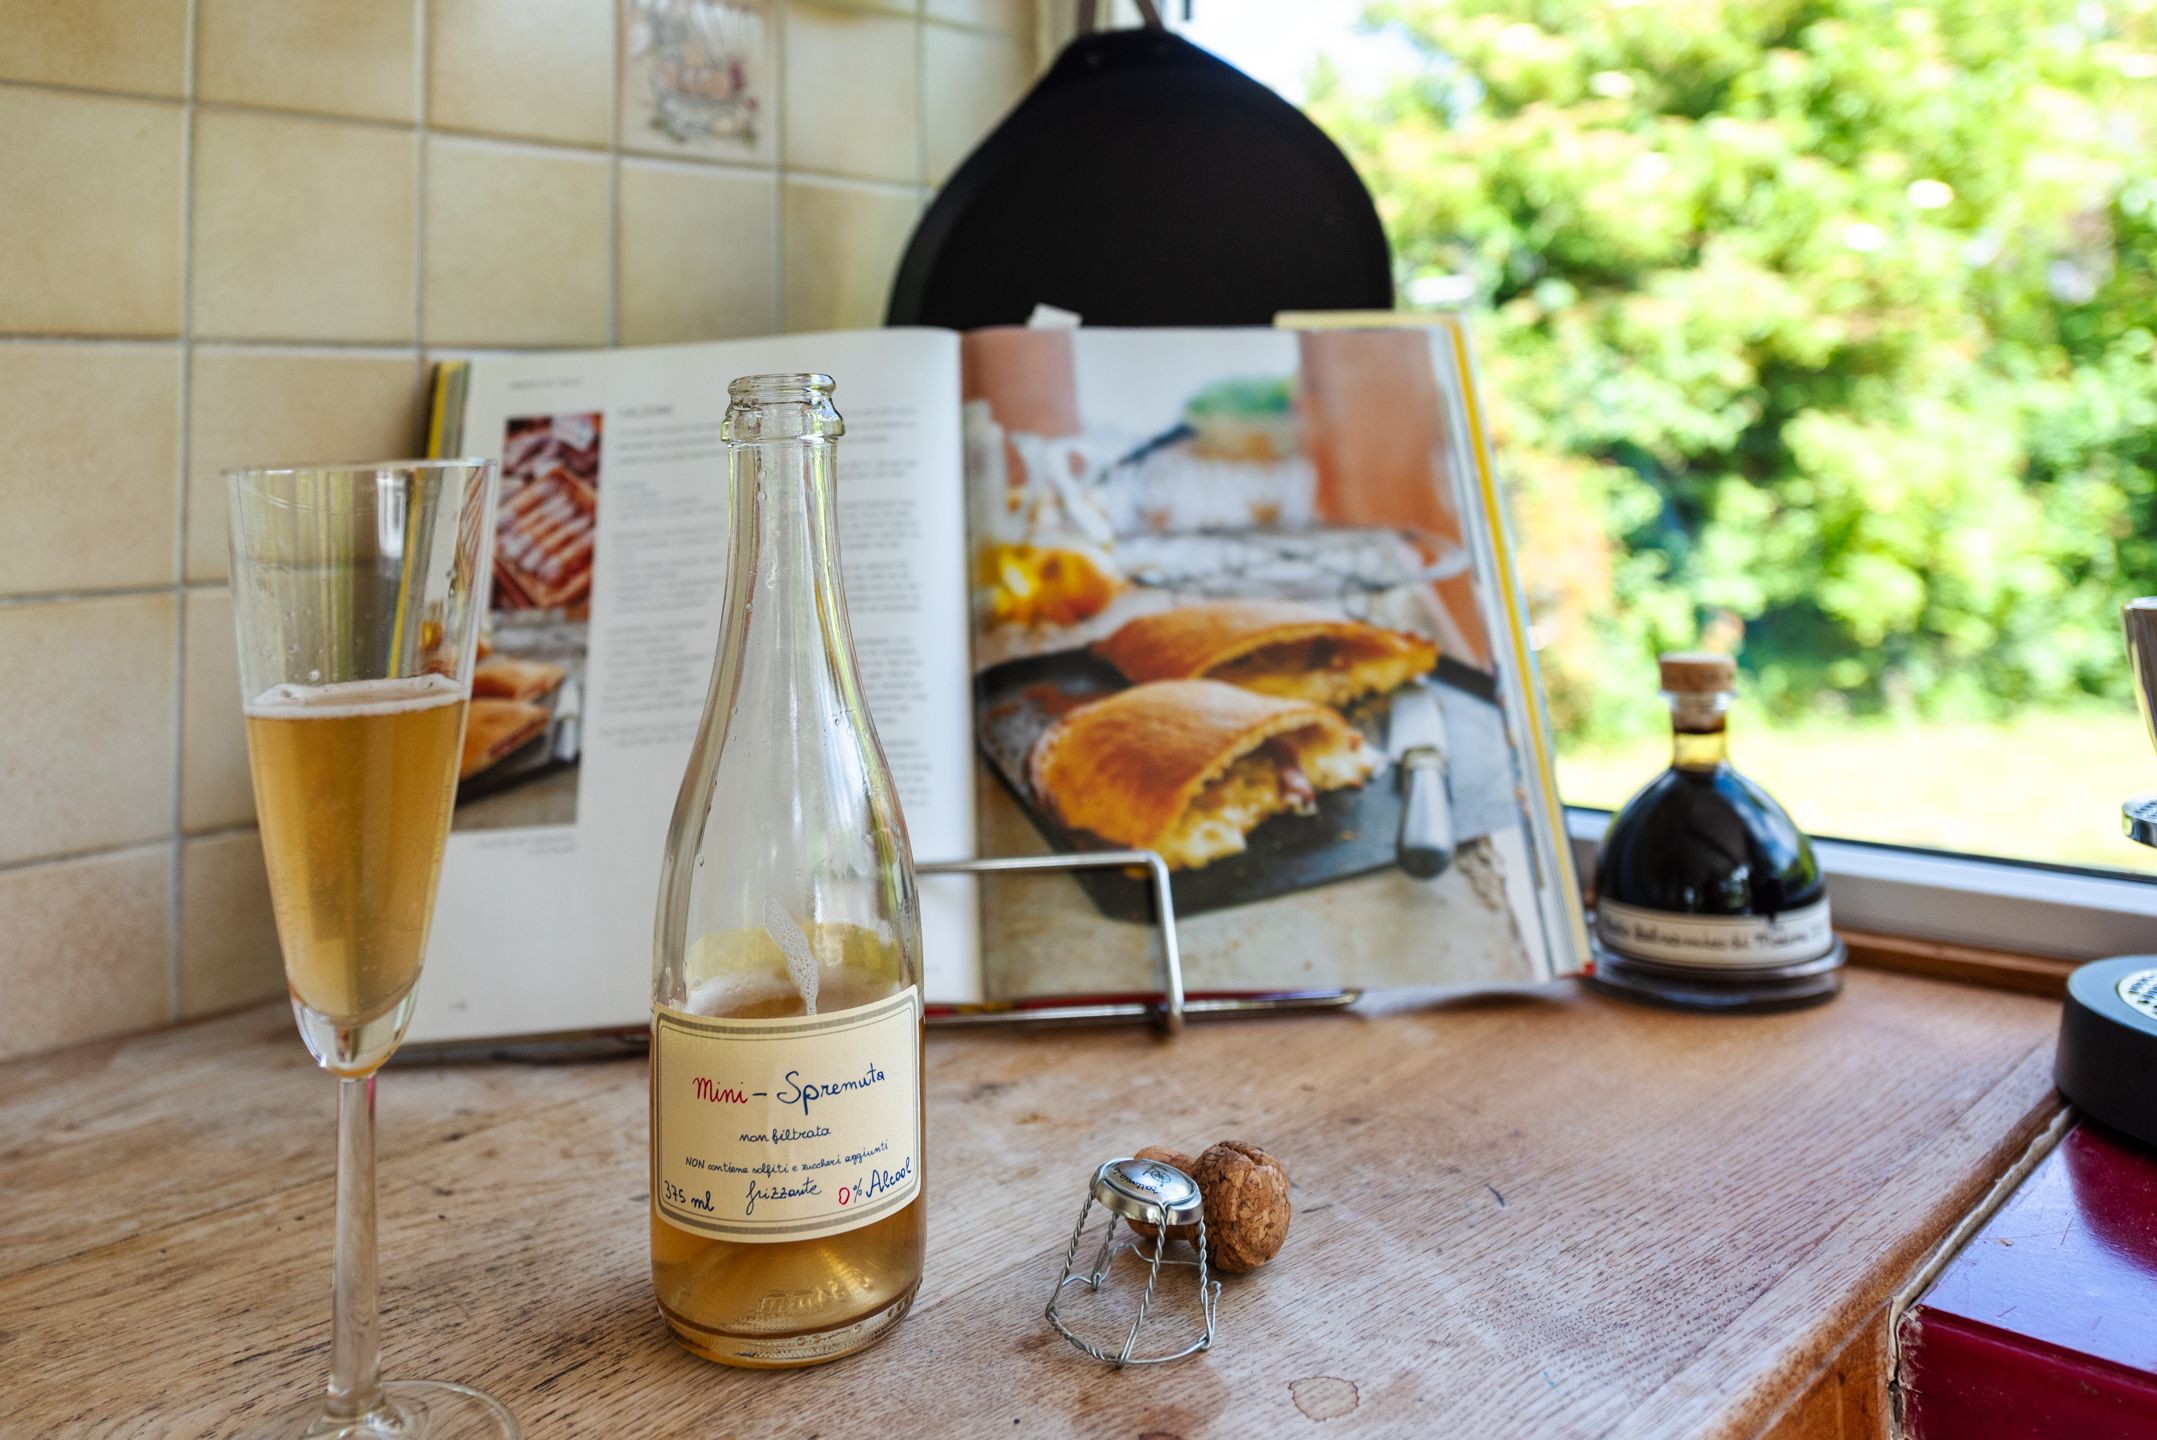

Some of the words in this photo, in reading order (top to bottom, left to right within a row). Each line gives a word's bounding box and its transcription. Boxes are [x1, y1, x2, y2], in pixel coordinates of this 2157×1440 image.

[692, 1077, 749, 1104] Mini
[776, 1062, 885, 1116] Spremuta
[739, 1132, 769, 1142] non
[772, 1126, 831, 1144] filtrata
[685, 1156, 705, 1169] NON
[707, 1162, 749, 1174] contiene
[752, 1163, 789, 1178] solfiti
[802, 1154, 842, 1171] zuccheri
[844, 1139, 888, 1166] aggiunti
[866, 1156, 912, 1198] Alcool
[664, 1180, 686, 1204] 375
[691, 1190, 715, 1212] ml
[745, 1176, 822, 1216] frizzante
